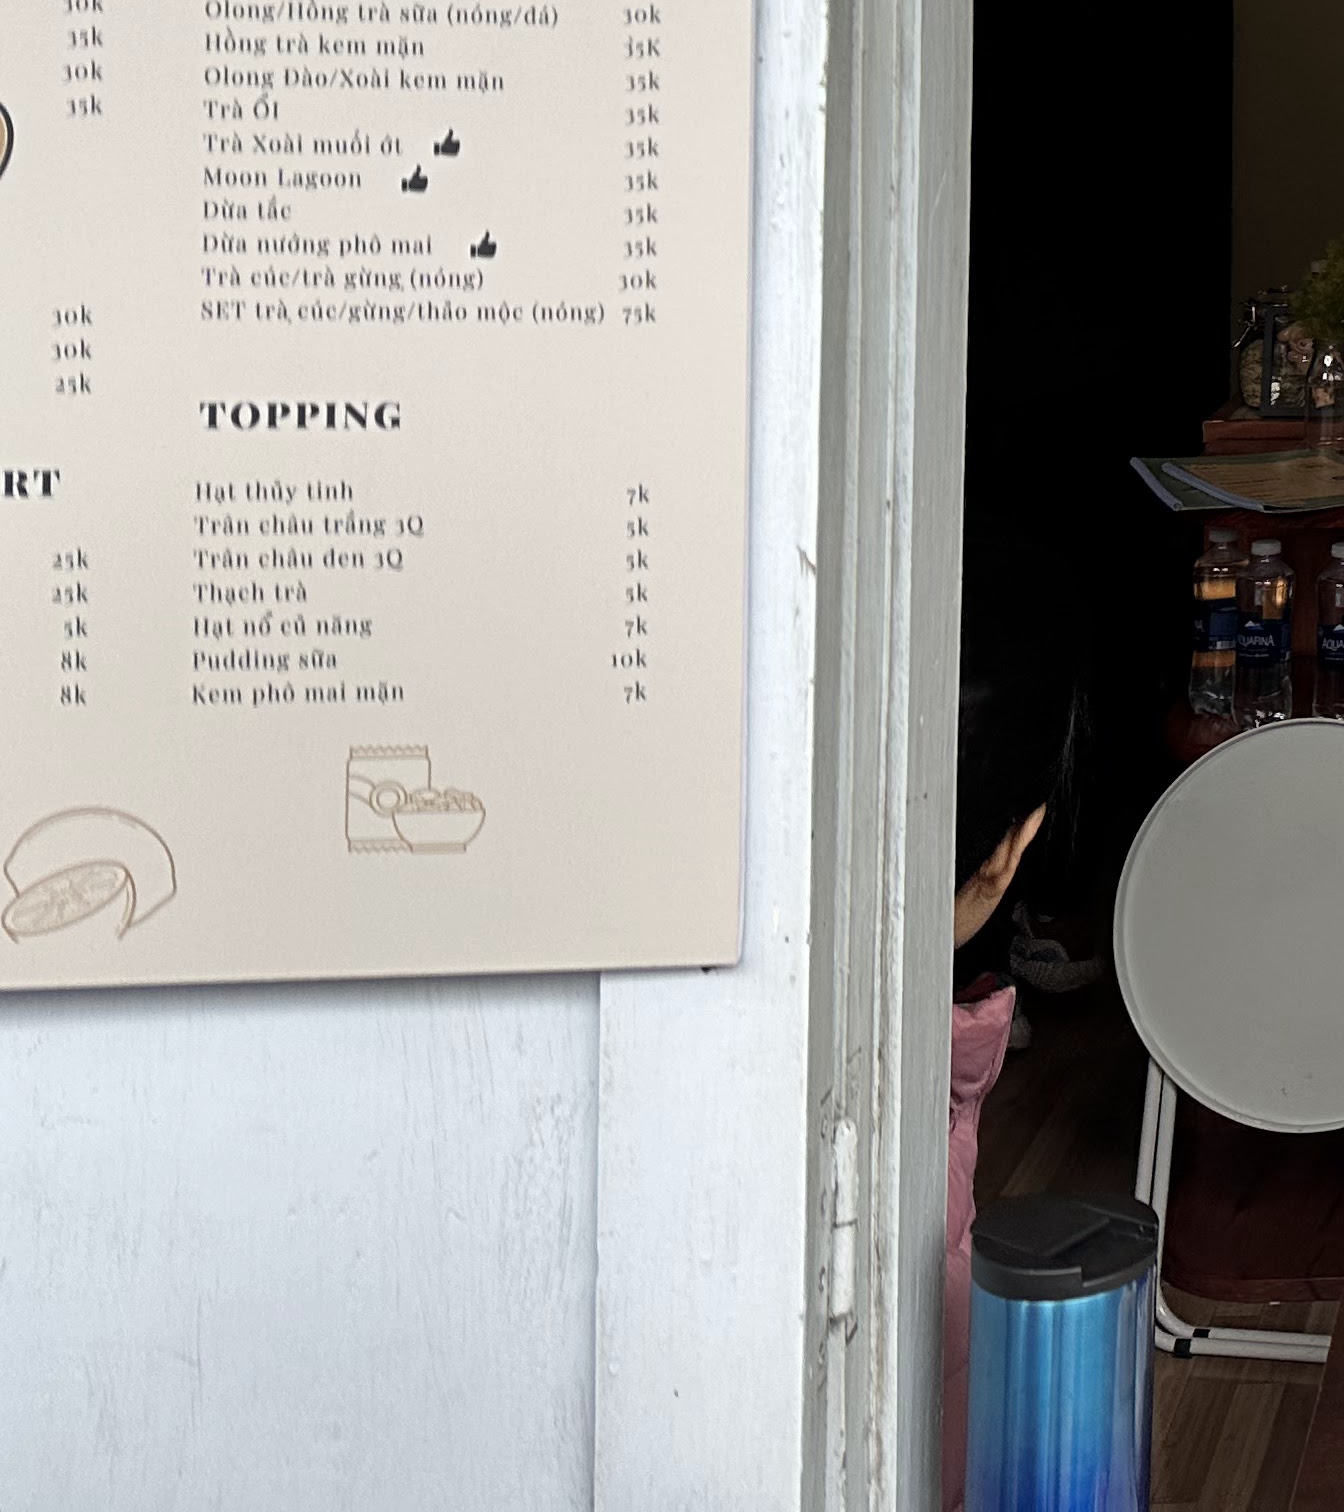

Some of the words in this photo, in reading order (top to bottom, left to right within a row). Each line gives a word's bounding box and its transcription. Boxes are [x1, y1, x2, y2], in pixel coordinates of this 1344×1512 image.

[358, 0, 390, 23] trà
[399, 1, 438, 24] sữa
[623, 2, 662, 26] 30k
[67, 25, 103, 48] 35k
[205, 25, 267, 56] Hồng
[276, 32, 309, 55] trà
[319, 31, 367, 55] kem
[62, 59, 103, 83] 30k
[204, 64, 275, 91] Olong
[400, 68, 447, 91] kem
[625, 70, 660, 93] 35k
[66, 93, 102, 118] 35k
[203, 97, 243, 121] Trà
[625, 103, 660, 126] 35k
[203, 131, 243, 155] Trà
[253, 131, 303, 155] Xoài
[313, 128, 371, 156] muối
[625, 136, 659, 159] 35k
[203, 165, 268, 189] Moon
[278, 167, 362, 190] Lagoon
[624, 169, 659, 192] 35k
[202, 197, 247, 222] Dừa
[624, 202, 658, 225] 35k
[202, 230, 247, 256] Dừa
[340, 232, 382, 259] phô
[391, 232, 432, 256] mai
[624, 236, 658, 259] 35k
[200, 264, 241, 288] Trà
[251, 264, 335, 289] cúc/trà
[410, 267, 484, 293] (nóng)
[618, 269, 657, 293] 30k
[51, 303, 92, 328] 30k
[200, 299, 246, 321] SET
[532, 300, 605, 326] (nóng)
[622, 301, 656, 326] 75k
[51, 338, 92, 363] 30k
[55, 371, 92, 396] 25k
[200, 399, 402, 433] TOPPING
[196, 481, 236, 506] Hạt
[307, 478, 354, 502] tinh
[626, 482, 649, 506] 7k
[193, 512, 250, 537] Trân
[258, 512, 314, 537] châu
[626, 515, 649, 539] 5k
[52, 545, 89, 571] 25k
[193, 546, 249, 570] Trân
[258, 546, 313, 570] châu
[626, 548, 649, 572] 5k
[51, 580, 88, 606] 25k
[192, 581, 264, 607] Thạch
[274, 579, 307, 603] trà
[625, 582, 648, 604] 5k
[63, 615, 88, 640] 5k
[193, 615, 234, 640] Hạt
[316, 614, 373, 640] năng
[624, 614, 648, 638] 7k
[1237, 634, 1276, 648] QUAFINA
[60, 648, 88, 672] 8k
[192, 648, 290, 673] Pudding
[611, 648, 648, 670] 10k
[60, 682, 87, 706] 8k
[192, 682, 242, 705] Kem
[252, 680, 296, 708] phô
[304, 680, 346, 704] mai
[623, 680, 647, 705] 7k
